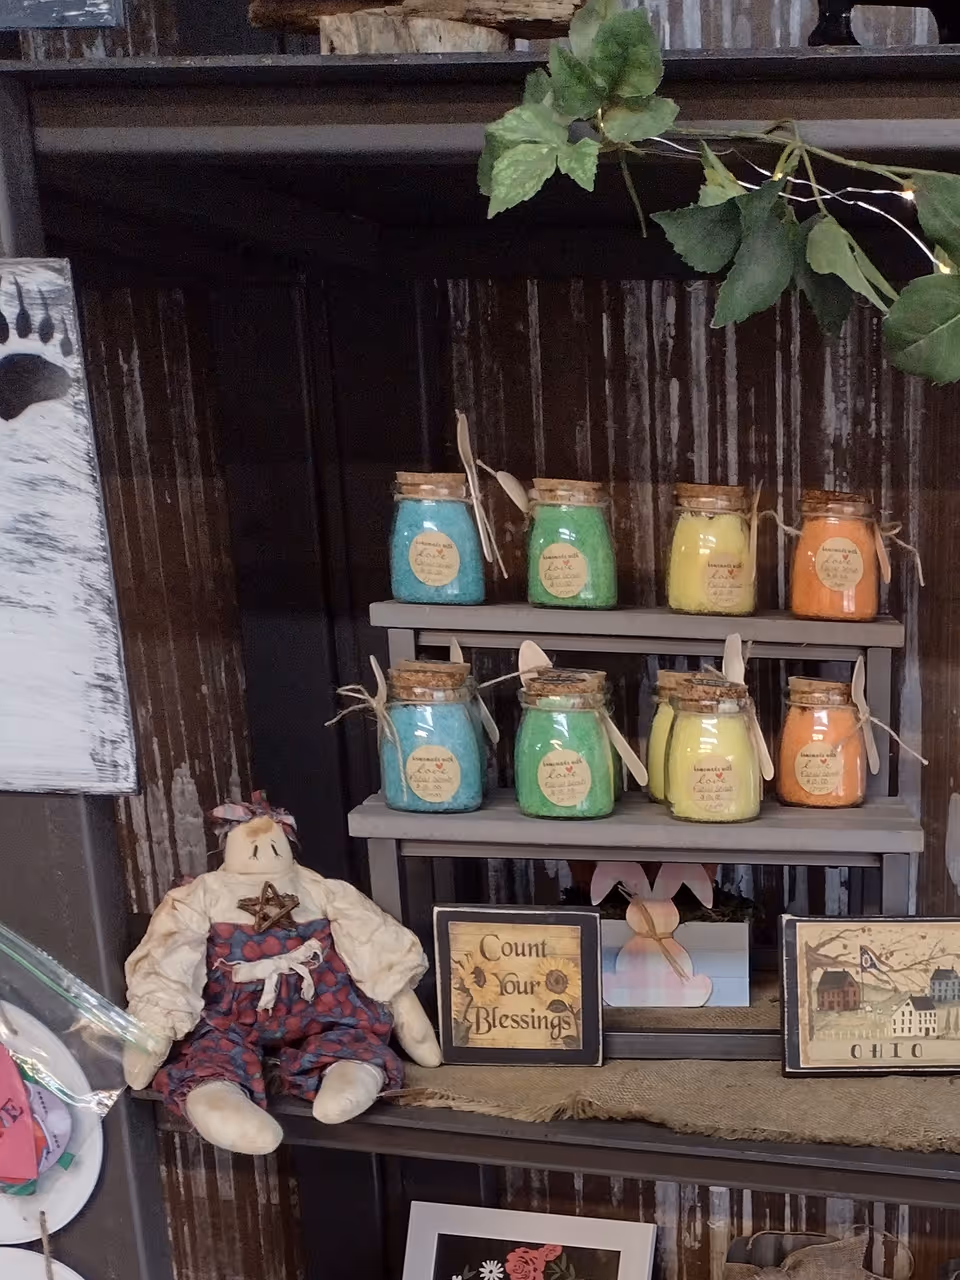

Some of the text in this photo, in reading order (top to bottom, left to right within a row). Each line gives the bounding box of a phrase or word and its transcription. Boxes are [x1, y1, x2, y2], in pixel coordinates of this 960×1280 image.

[479, 934, 548, 962] Count
[491, 972, 541, 996] Your
[472, 1006, 571, 1040] Blessings
[850, 1043, 923, 1059] OHIO
